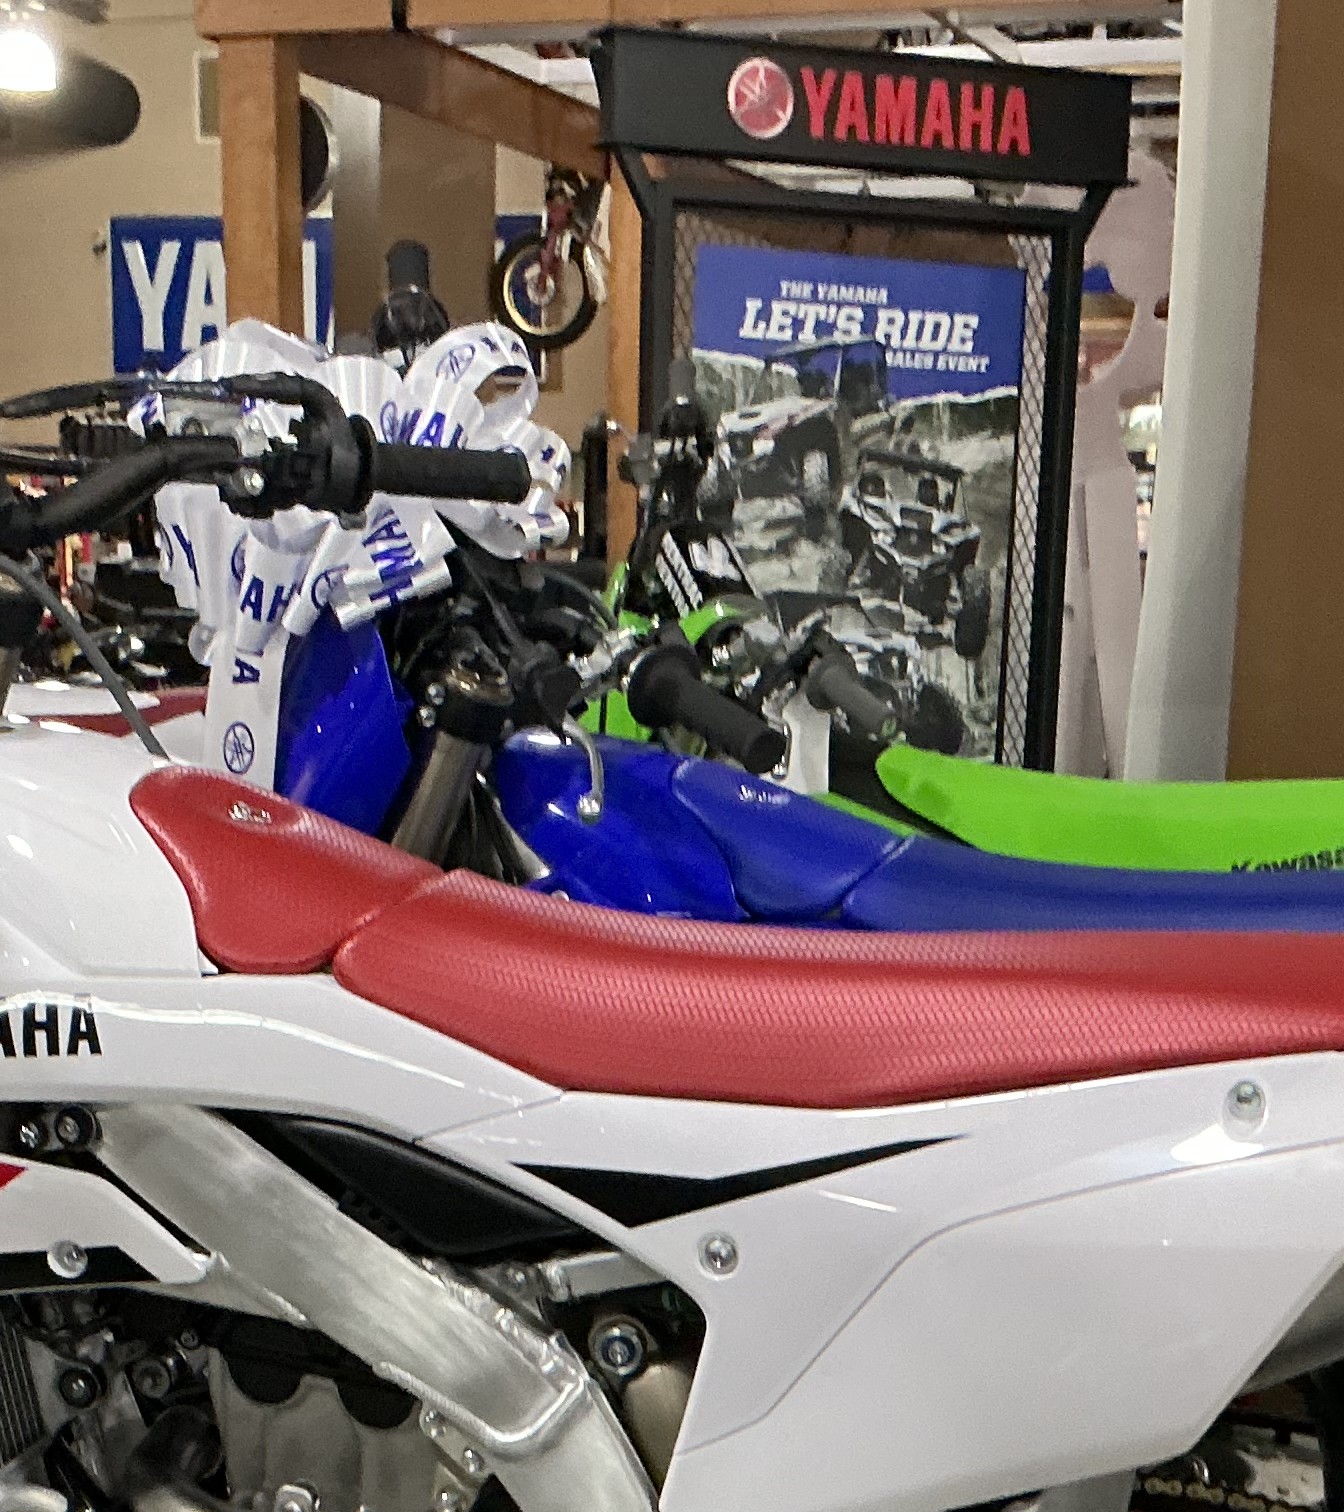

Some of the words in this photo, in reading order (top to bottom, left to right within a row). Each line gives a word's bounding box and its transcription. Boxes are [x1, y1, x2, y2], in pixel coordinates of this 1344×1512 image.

[800, 65, 1031, 156] YAMAHA
[780, 280, 813, 299] THE
[817, 283, 888, 305] YAMAHA
[739, 297, 864, 343] LET'S
[875, 306, 979, 353] RIDE
[936, 353, 990, 373] EVENT
